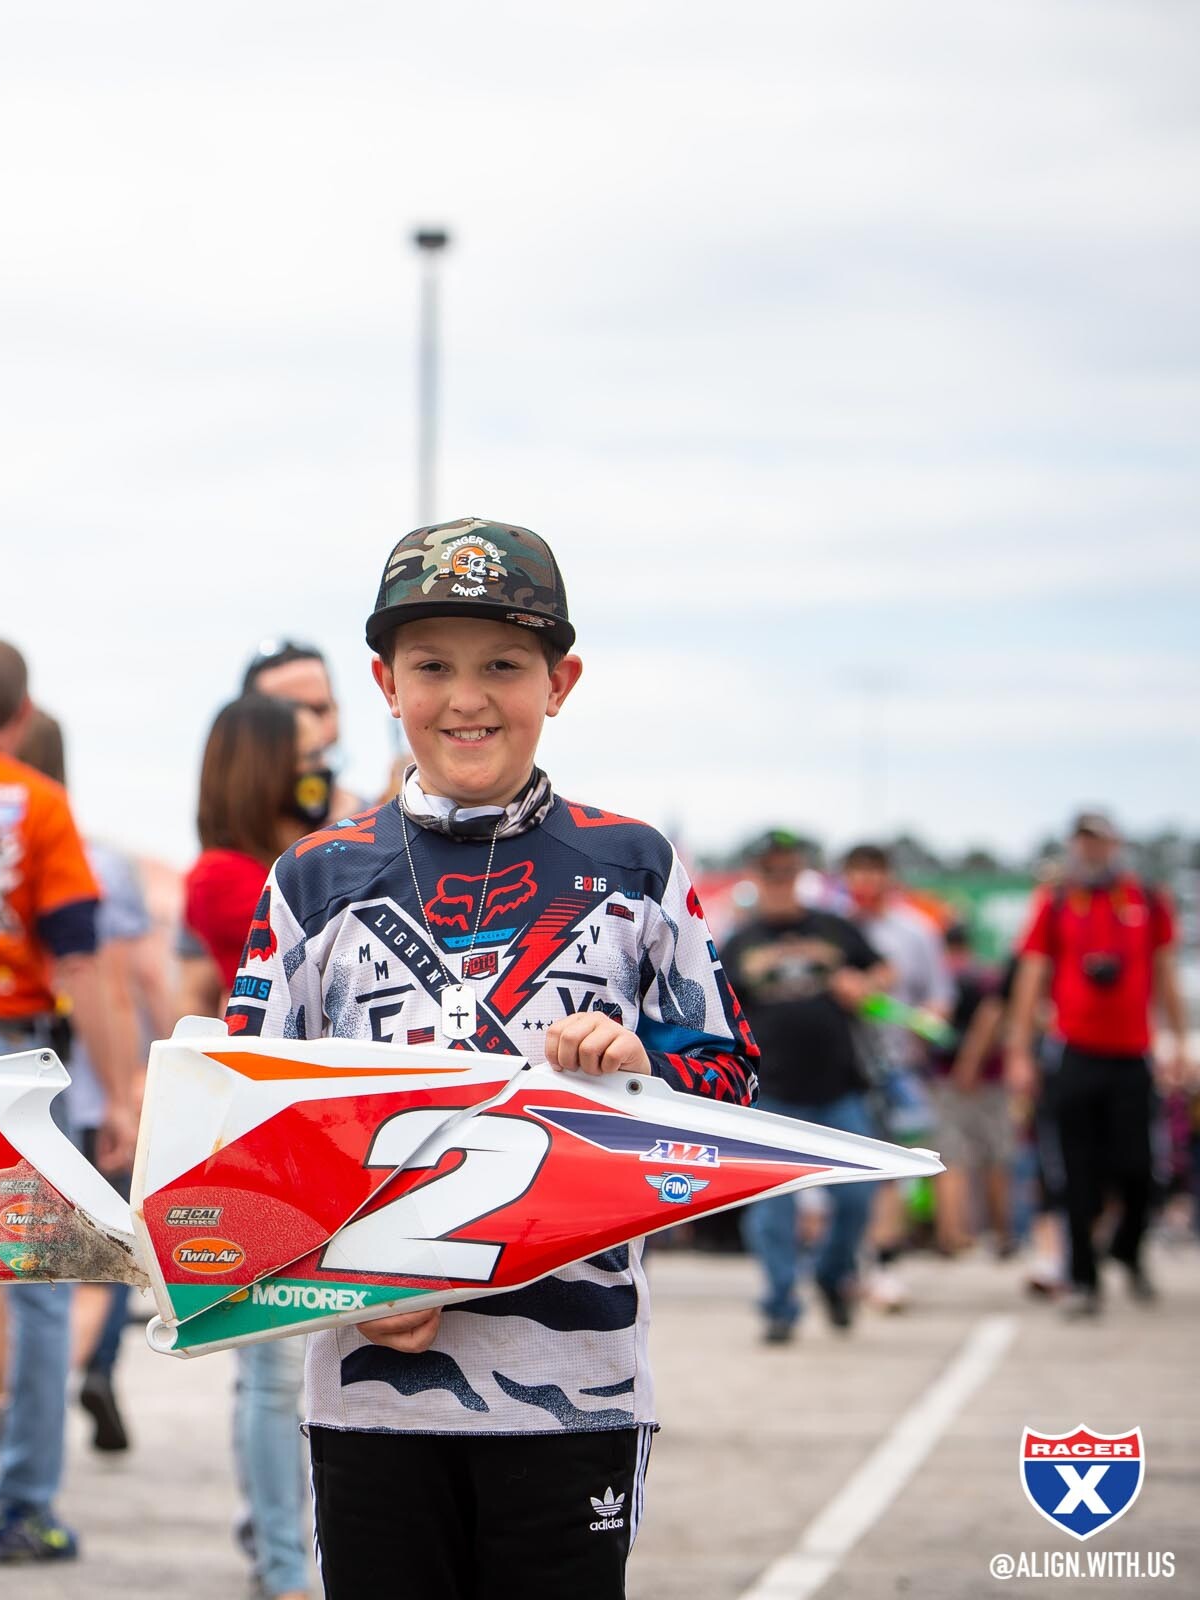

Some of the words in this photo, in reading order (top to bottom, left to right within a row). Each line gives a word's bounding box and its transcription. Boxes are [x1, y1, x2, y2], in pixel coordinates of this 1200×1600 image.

[441, 535, 484, 560] DANGER
[484, 542, 502, 564] BOY
[451, 583, 488, 597] DNGR
[574, 876, 607, 893] 2016
[647, 1142, 717, 1163] AMA
[316, 1106, 552, 1284] 2
[665, 1181, 688, 1195] FIM
[179, 1249, 216, 1263] Twin
[216, 1249, 241, 1263] Air
[252, 1284, 367, 1311] MOTOREX
[589, 1517, 624, 1531] adidas
